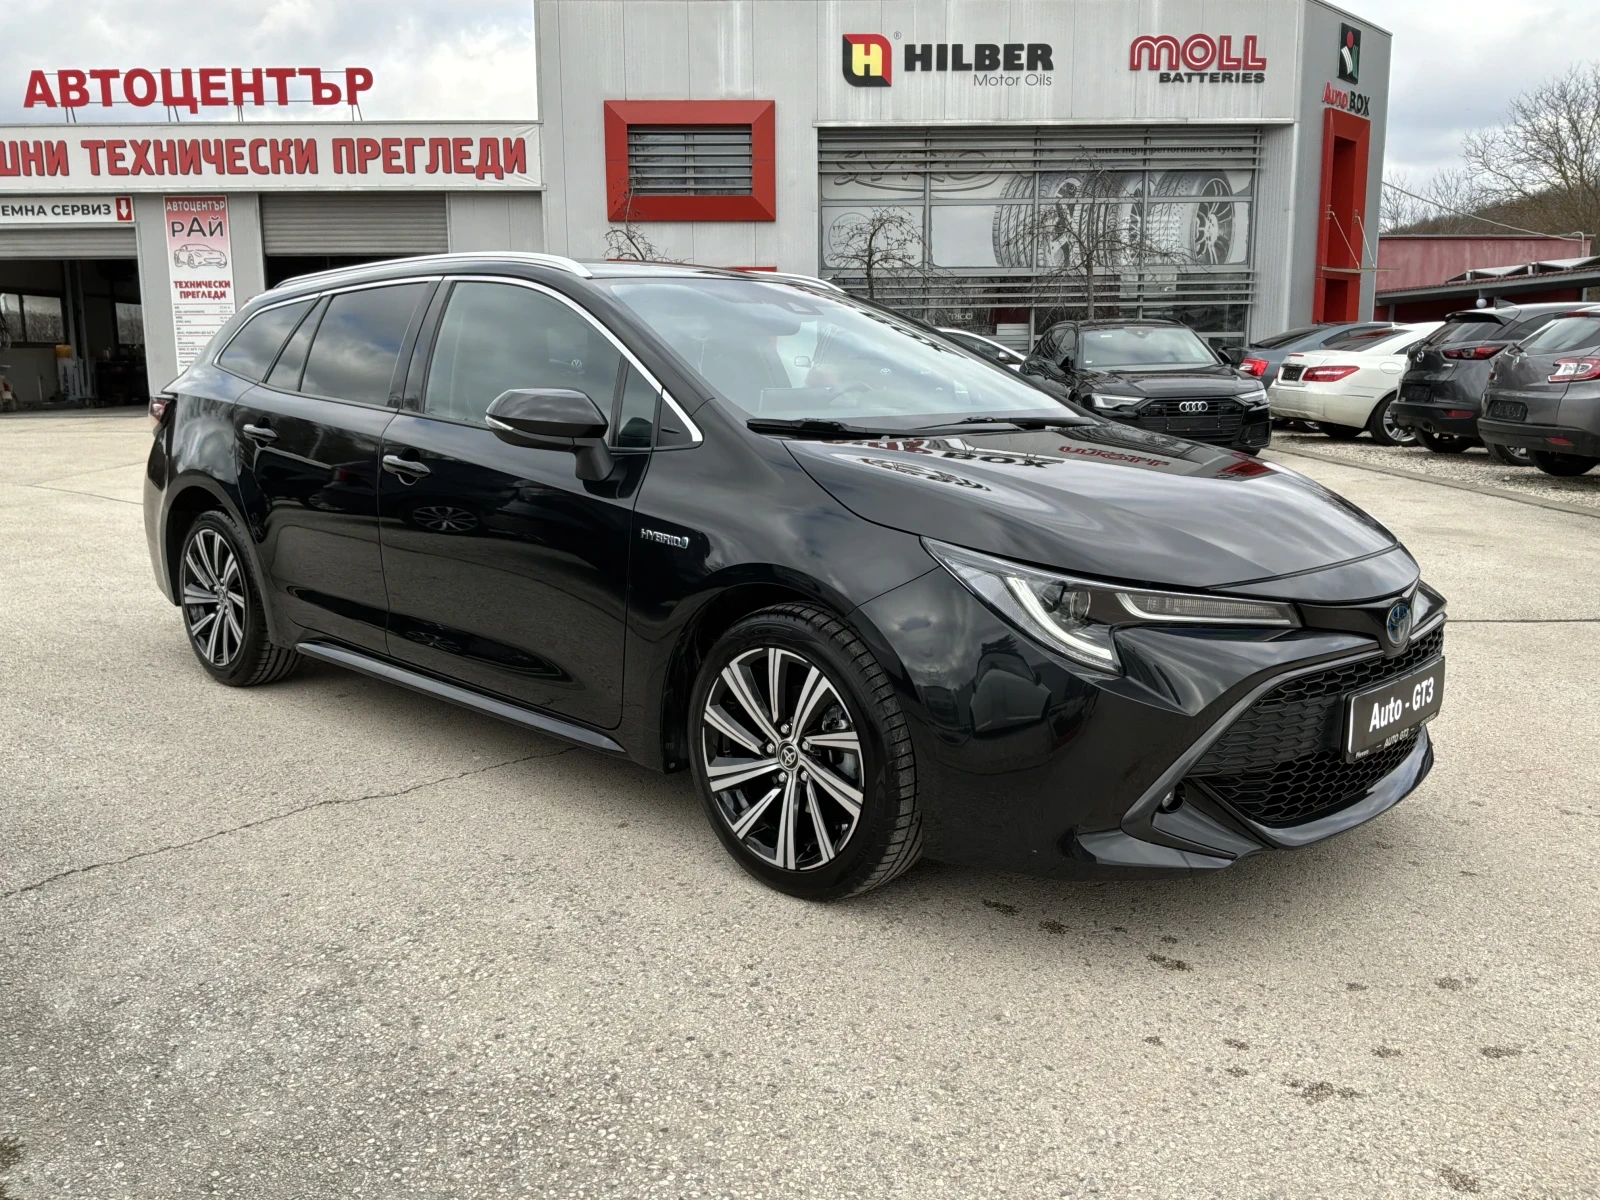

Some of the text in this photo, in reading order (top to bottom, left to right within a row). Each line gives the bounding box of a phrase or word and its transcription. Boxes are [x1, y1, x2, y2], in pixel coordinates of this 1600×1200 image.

[904, 43, 1054, 72] HILBER
[1129, 33, 1267, 71] MOLL
[973, 72, 1052, 86] Motor Oils
[1159, 72, 1265, 84] BATTERIES
[23, 67, 374, 115] АВТОЦЕНТЪР
[1349, 90, 1370, 115] BOX
[81, 137, 319, 176] ТЕХНИЧЕСКИ
[332, 137, 527, 181] ПРЕГЛЕДИ
[1, 203, 111, 216] ЕМНА СЕРВИЗ
[166, 200, 225, 213] АВТОЦЕНТЪР
[171, 216, 223, 238] РАЙ
[173, 280, 231, 290] ТЕХНИЧЕСКИ
[179, 290, 227, 300] ПРЕГЛЕДИ
[640, 528, 683, 547] HYBRID
[1369, 696, 1402, 732] Auto
[1412, 676, 1434, 711] GT3
[1383, 733, 1398, 748] AUTO
